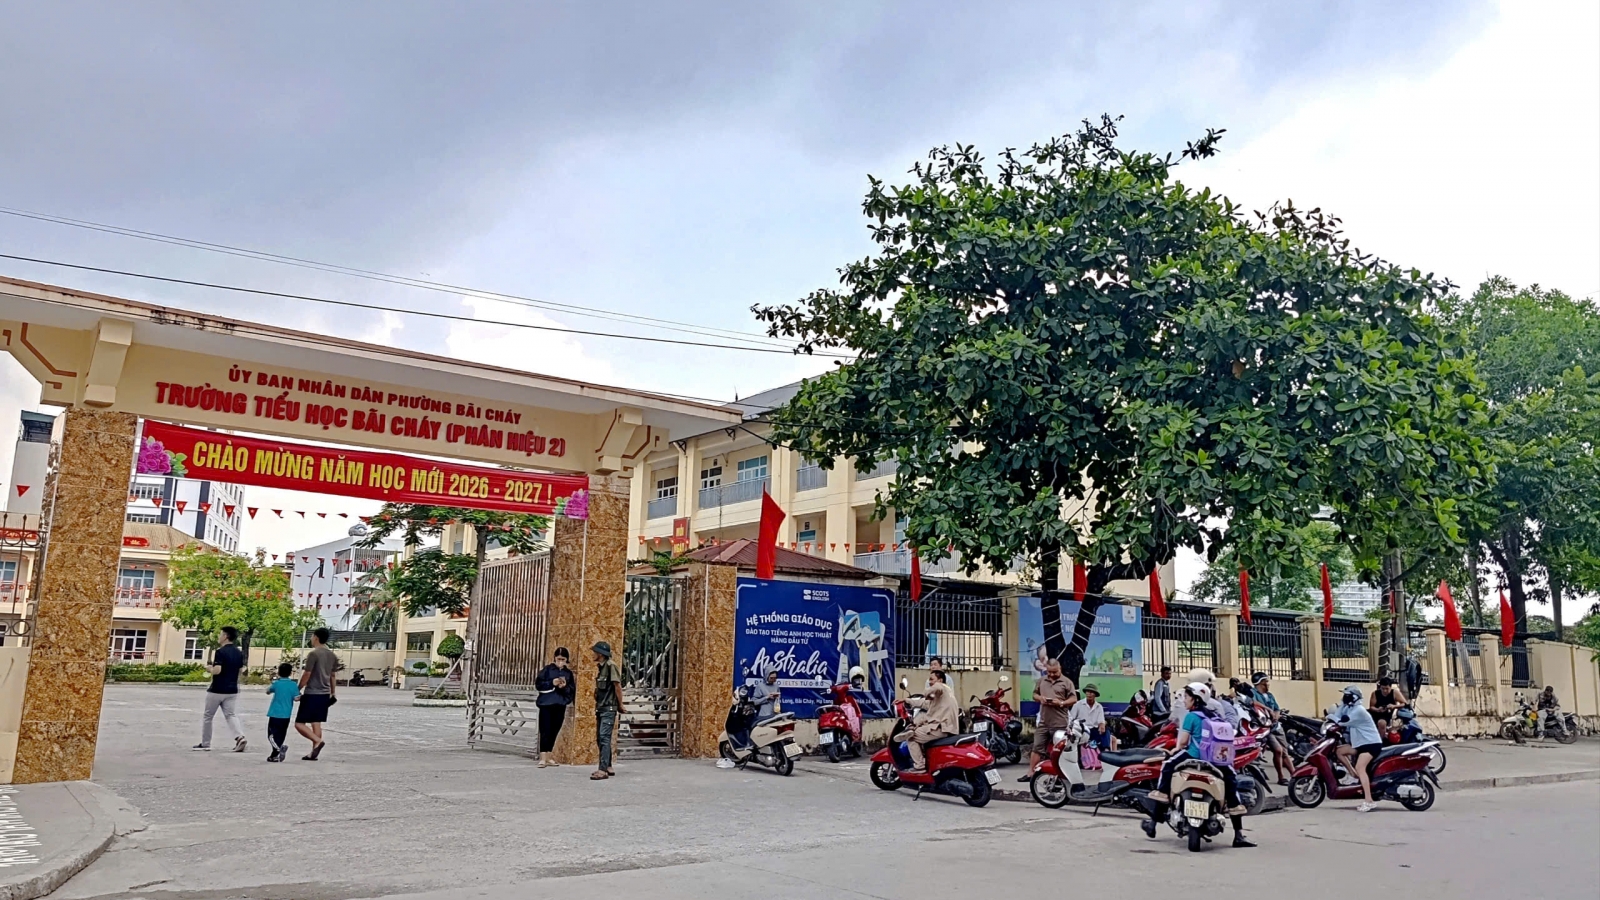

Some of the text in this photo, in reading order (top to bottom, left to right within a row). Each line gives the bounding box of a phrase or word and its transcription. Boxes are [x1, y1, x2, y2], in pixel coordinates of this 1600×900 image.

[229, 364, 521, 425] ỦY BAN NHÂN DÂN PHƯỜNG BÃI CHÁY
[156, 381, 567, 458] TRƯỜNG TIỂU HỌC BÃI CHÁY (PHÂN HIỆU 2)
[193, 440, 249, 472] CHÀO
[254, 447, 314, 480] MỪNG
[319, 454, 364, 486] NĂM
[368, 463, 405, 494] HỌC
[410, 466, 444, 494] MỚI
[448, 473, 489, 499] 2026
[503, 480, 542, 504] 2027
[546, 483, 553, 504] !
[746, 611, 833, 631] HỆ THỐNG GIÁO DỤC
[759, 628, 770, 637] TẠO
[771, 627, 788, 637] TIẾNG
[802, 631, 814, 640] HỌC
[815, 632, 832, 640] THUẬT
[1099, 627, 1110, 636] HAY
[771, 636, 787, 644] HÀNG
[751, 645, 828, 677] Australia
